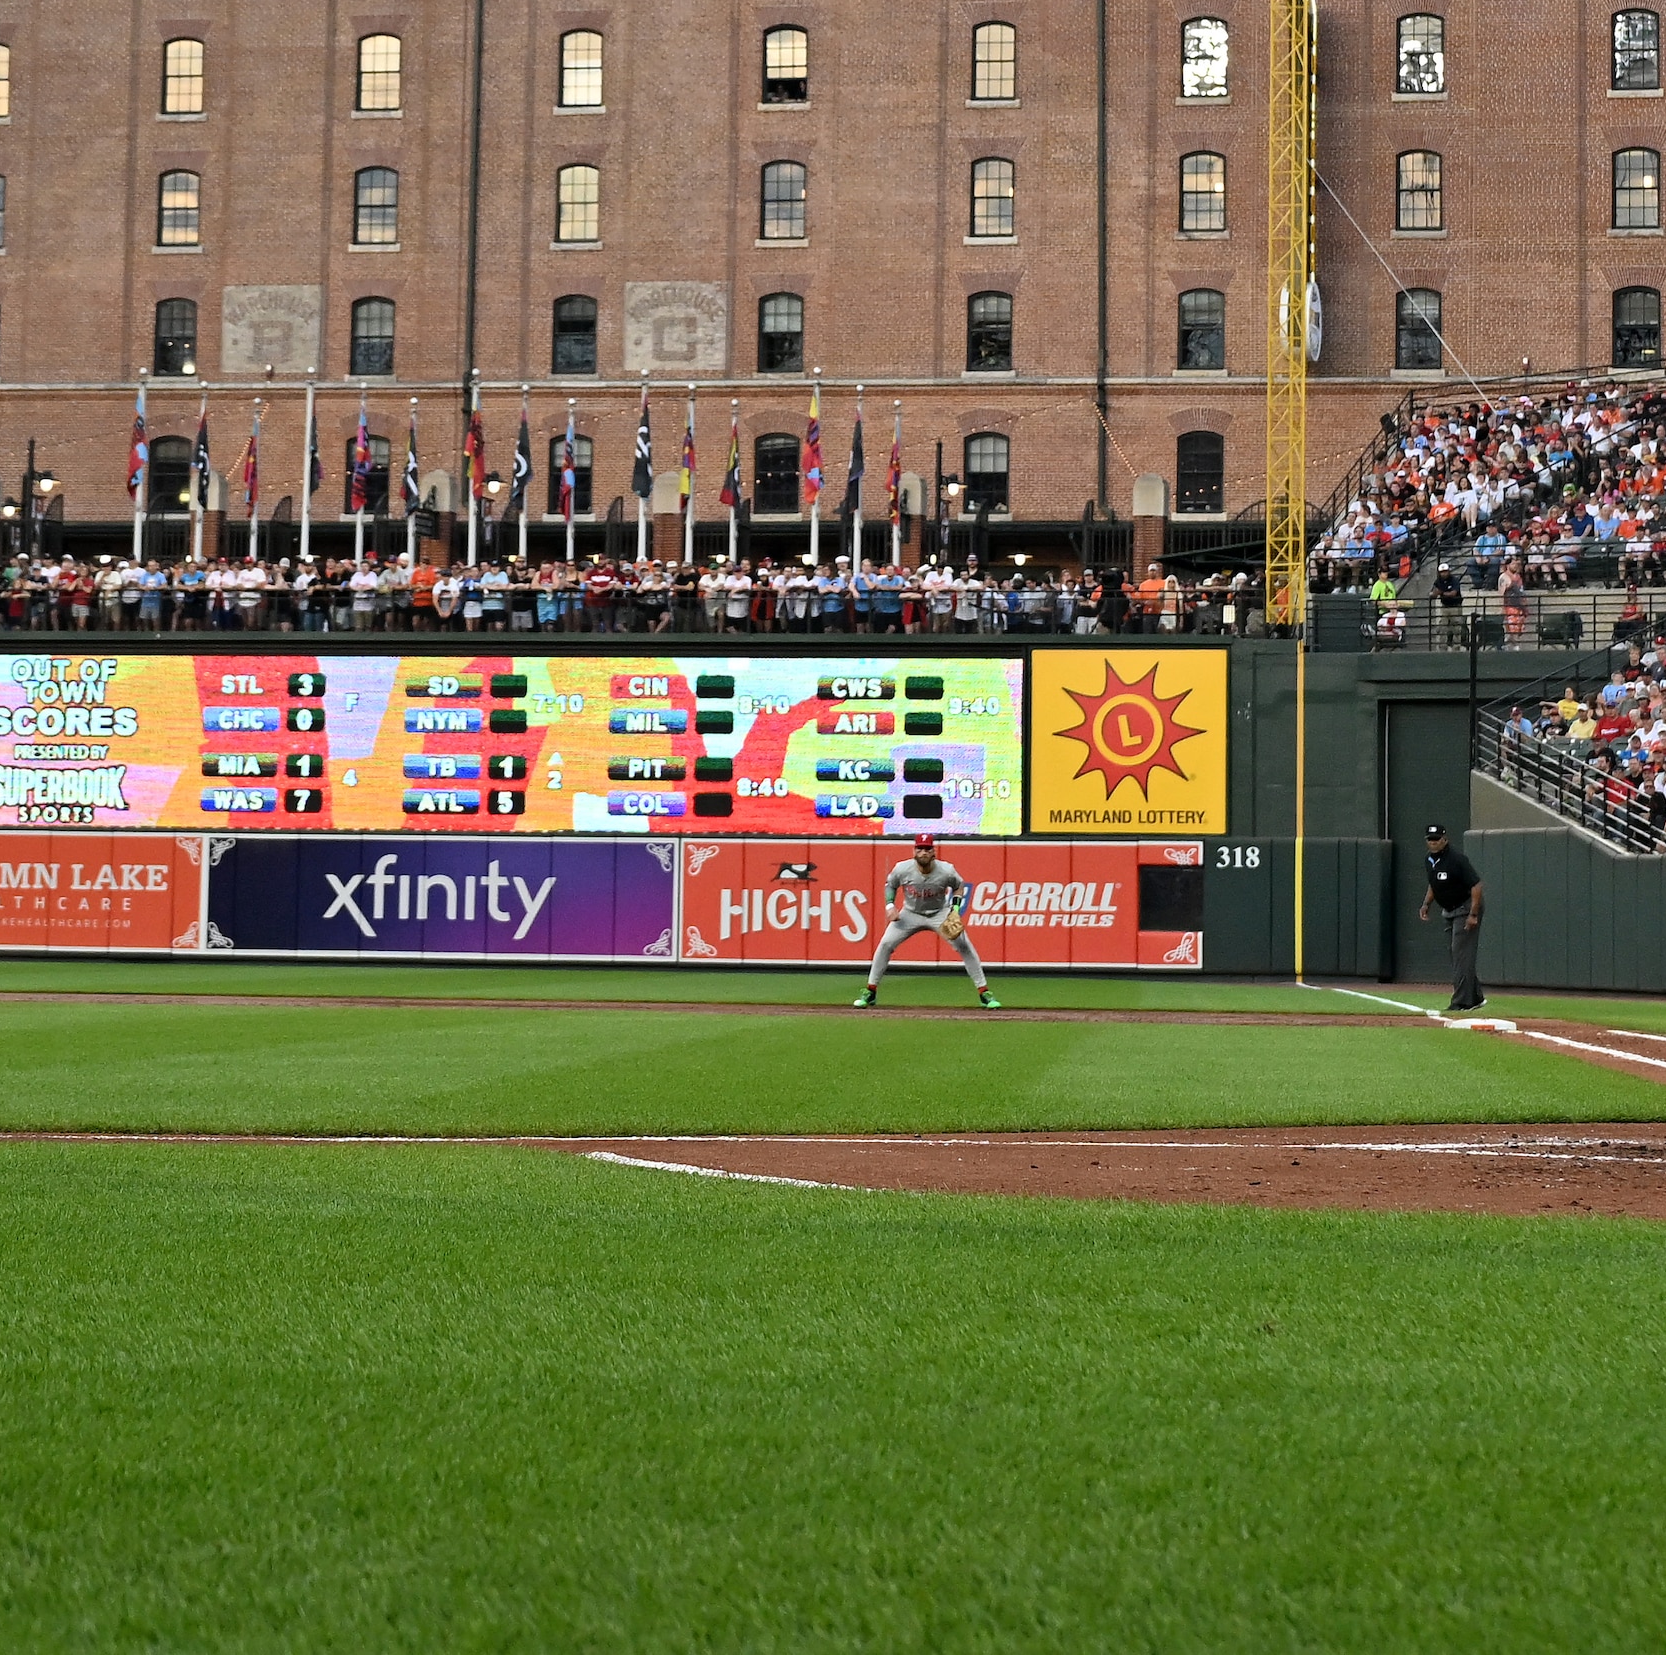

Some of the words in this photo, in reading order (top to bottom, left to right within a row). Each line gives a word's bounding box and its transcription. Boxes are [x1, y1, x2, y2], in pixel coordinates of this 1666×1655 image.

[12, 658, 72, 683] OUT
[80, 658, 117, 682] OF
[22, 680, 105, 704] TOWN
[221, 676, 264, 694] STL
[297, 677, 314, 695] 3
[427, 677, 459, 695] SD
[628, 678, 668, 696] CIN
[831, 678, 882, 698] CWS
[532, 694, 583, 712] 7:10
[948, 696, 1000, 715] 9:40
[218, 710, 264, 729] CHC
[416, 712, 467, 731] NYM
[626, 712, 667, 731] MIL
[834, 714, 876, 733] ARI
[1116, 714, 1142, 747] L
[14, 744, 89, 760] PRESENTED
[89, 744, 109, 760] BY
[217, 756, 260, 775] MIA
[296, 757, 310, 776] 1
[427, 757, 457, 776] TB
[502, 757, 514, 776] 1
[627, 758, 667, 778] PIT
[838, 760, 871, 780] KC
[342, 769, 357, 786] 4
[547, 771, 562, 788] 2
[945, 780, 1011, 799] 10:10
[214, 791, 264, 810] WAS
[293, 792, 310, 810] 7
[417, 793, 463, 812] ATL
[498, 793, 513, 811] 5
[623, 794, 668, 814] COL
[830, 796, 879, 816] LAD
[18, 805, 93, 823] SPORTS
[1049, 810, 1132, 824] MARYLAND
[1138, 810, 1205, 824] LOTTERY
[1216, 846, 1261, 869] 318
[70, 864, 168, 891] LAKE
[322, 854, 557, 941] xfinity
[971, 881, 1118, 912] CARROLL
[720, 889, 868, 942] HIGH'S
[968, 913, 1047, 927] MOTOR
[1049, 913, 1115, 927] FUELS
